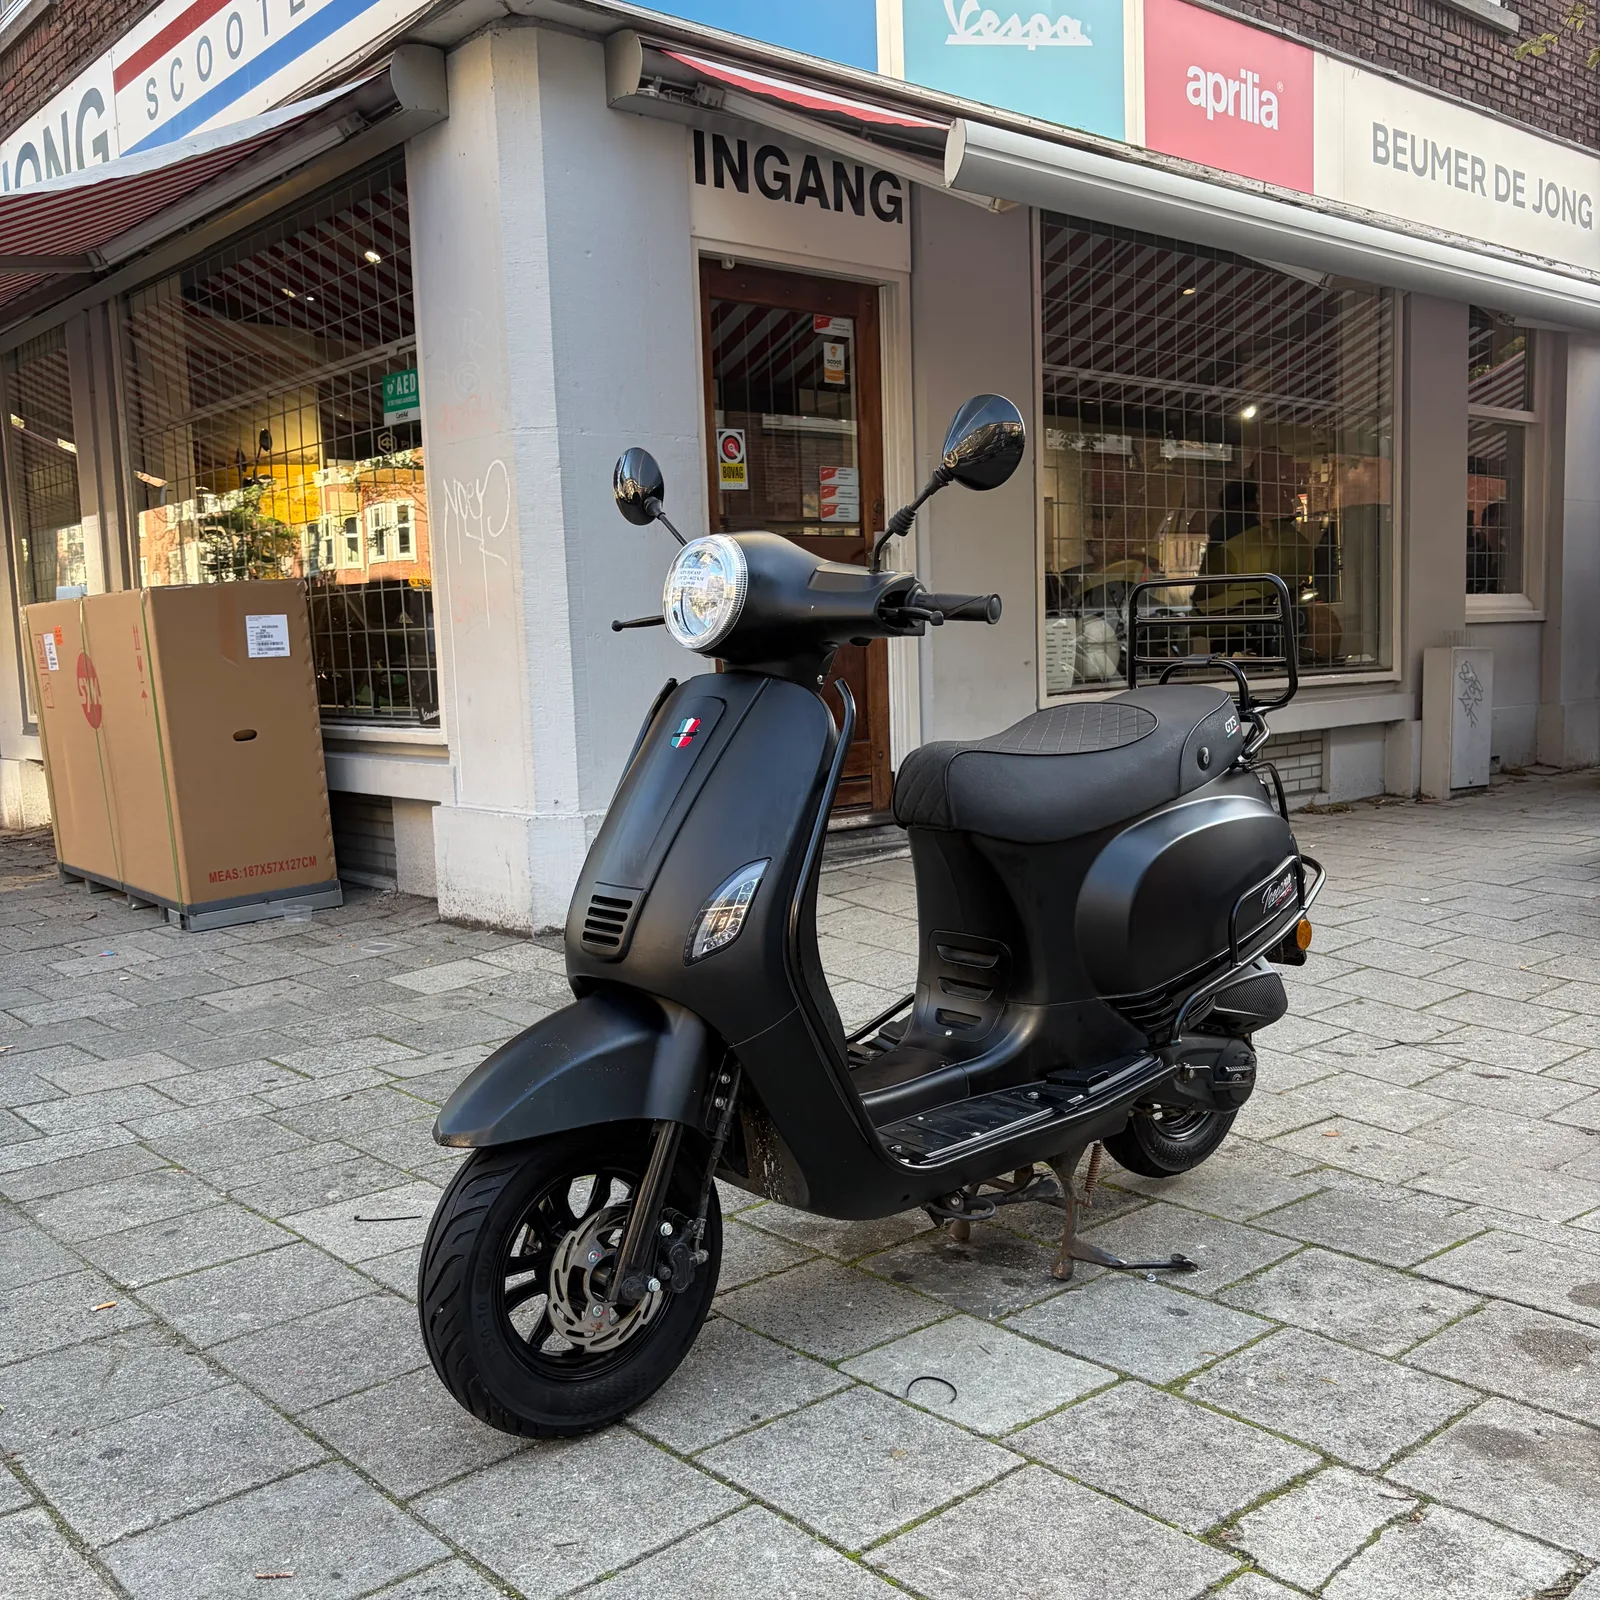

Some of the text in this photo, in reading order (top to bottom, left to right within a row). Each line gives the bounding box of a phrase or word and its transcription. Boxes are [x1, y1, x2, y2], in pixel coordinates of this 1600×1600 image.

[944, 0, 1093, 51] Vespa
[1186, 64, 1280, 131] aprilia
[693, 129, 904, 225] INGANG
[1372, 121, 1594, 231] BEUMER DE JONG
[396, 373, 416, 395] AED
[722, 466, 744, 480] BOVAG
[1225, 715, 1237, 734] GTS
